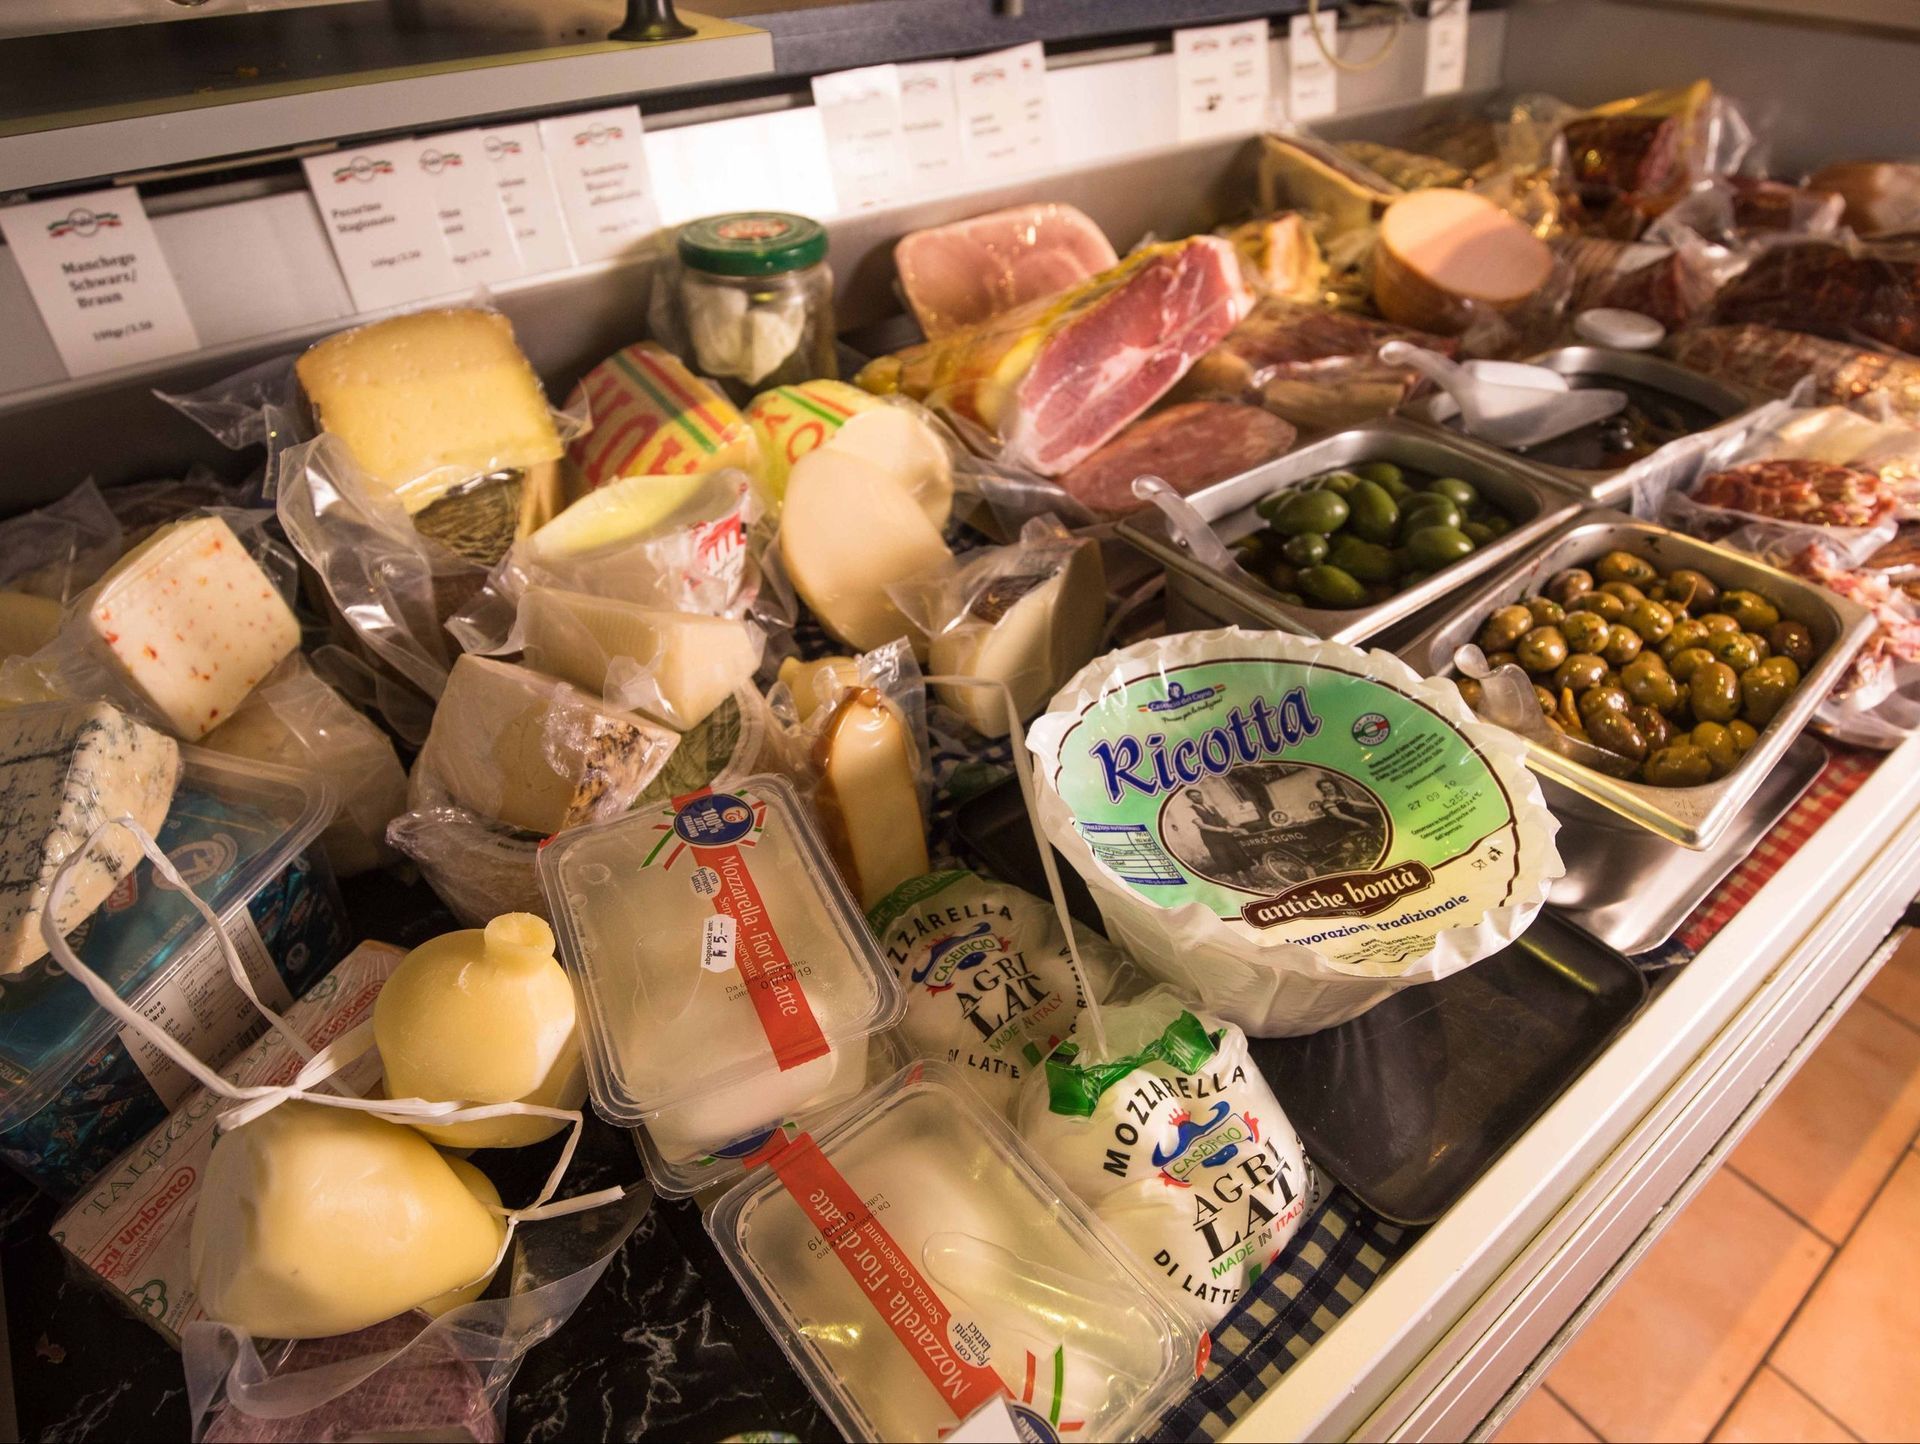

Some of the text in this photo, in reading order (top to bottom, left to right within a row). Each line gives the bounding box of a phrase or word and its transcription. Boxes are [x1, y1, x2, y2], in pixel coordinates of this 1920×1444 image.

[62, 252, 137, 275] Manchego
[76, 290, 124, 309] Braun
[1094, 686, 1321, 803] Ricotta
[682, 815, 699, 838] ITALIANO
[701, 808, 725, 834] 100%
[1408, 800, 1422, 811] 27
[695, 867, 715, 895] fermenti
[709, 872, 719, 885] con
[1257, 867, 1420, 922] antiche bontà
[719, 896, 735, 919] Senz
[1377, 894, 1469, 932] tradizionale
[704, 932, 714, 966] abgepackt
[718, 855, 761, 926] Mozzarella
[750, 929, 775, 959] Fior
[770, 972, 799, 1016] Latte
[887, 903, 1012, 978] ZZARELLA
[934, 938, 996, 982] CASEIFICIO
[955, 951, 1033, 1019] AGRI
[965, 971, 1050, 1044] LAT
[1032, 993, 1064, 1024] ITALY
[1103, 1065, 1248, 1178] MOZZARELLA
[1172, 1126, 1242, 1176] CASEIFICIO
[1193, 1137, 1285, 1227] AGRI
[118, 1173, 191, 1245] Umberto
[809, 1188, 848, 1226] Latte
[1195, 1160, 1298, 1263] LAT
[1211, 1198, 1306, 1280] MADE IN ITALY
[853, 1248, 890, 1292] Fior
[860, 1222, 943, 1325] Senza Conservanti
[1153, 1248, 1241, 1304] DI LATTE
[888, 1290, 972, 1400] Mozzarella
[952, 1323, 991, 1367] fermenti
[955, 1341, 971, 1361] con
[965, 1321, 992, 1353] lattici
